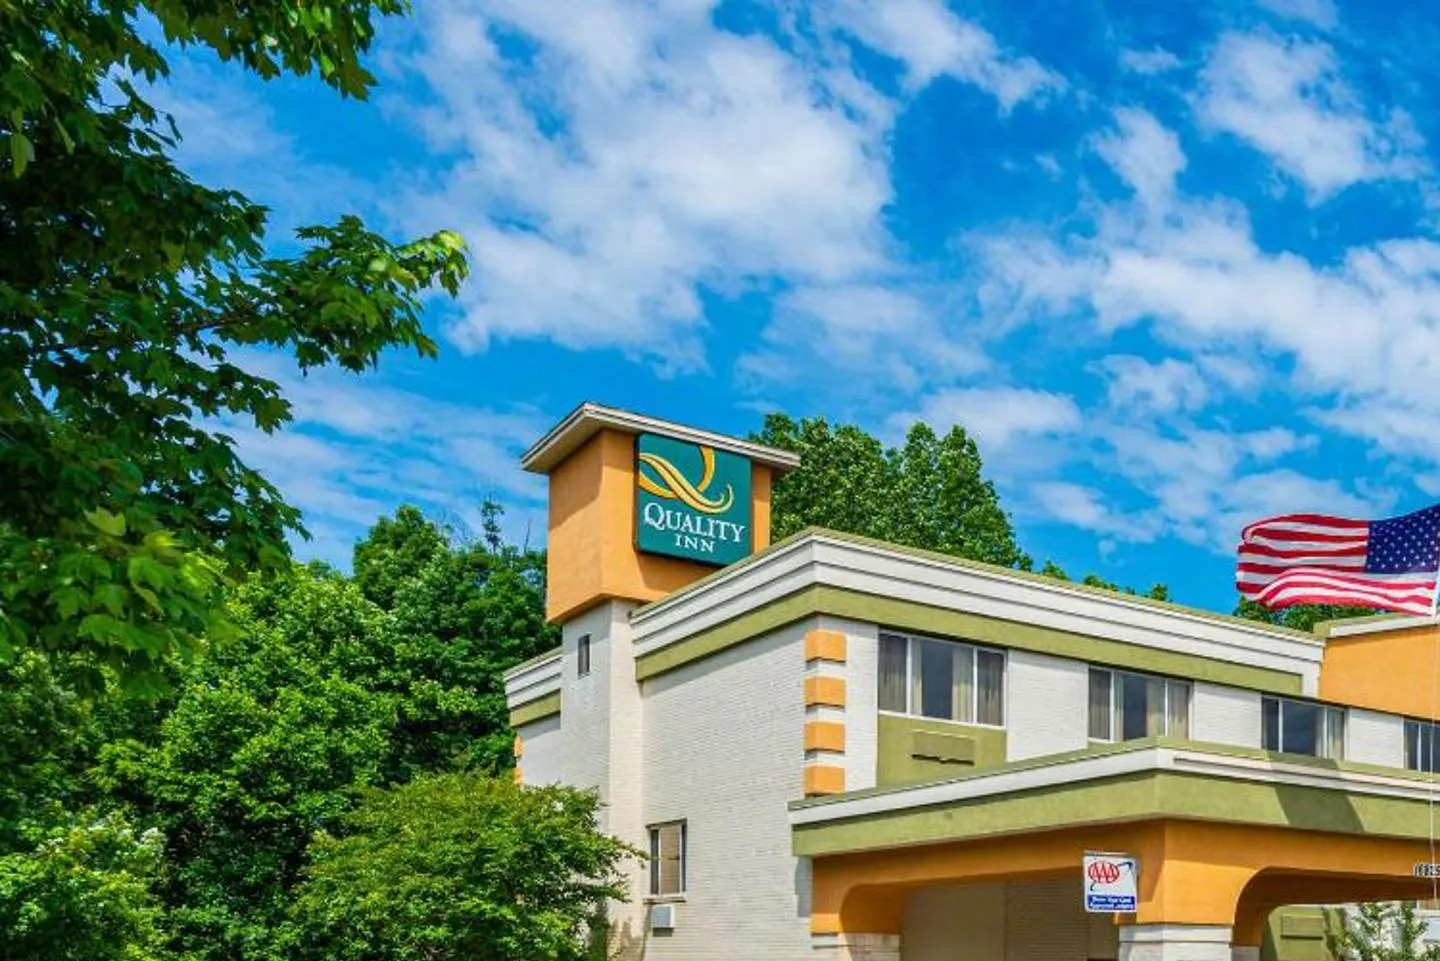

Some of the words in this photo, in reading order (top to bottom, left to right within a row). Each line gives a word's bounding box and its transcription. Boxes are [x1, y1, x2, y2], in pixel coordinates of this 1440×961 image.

[644, 502, 746, 542] QUALITY
[675, 533, 715, 553] INN
[1089, 861, 1119, 884] AAA
